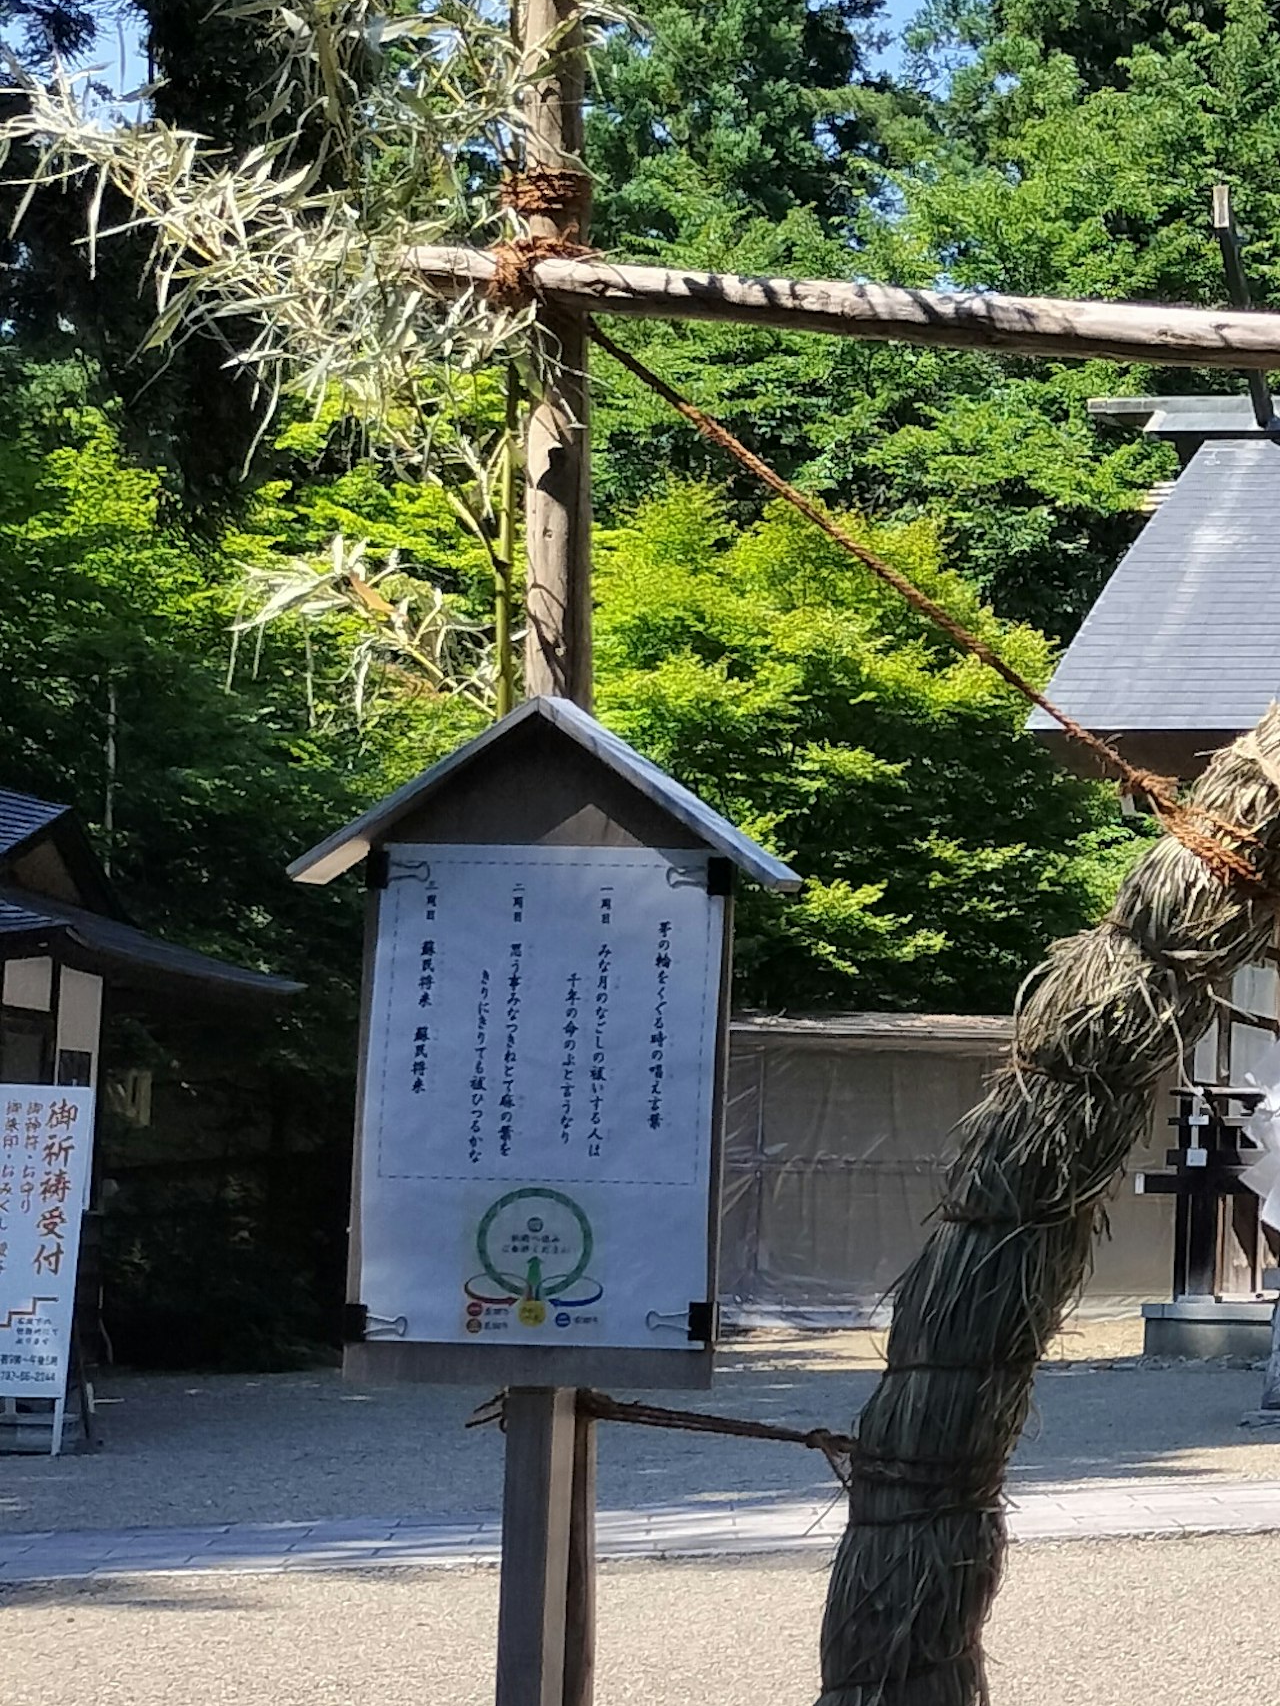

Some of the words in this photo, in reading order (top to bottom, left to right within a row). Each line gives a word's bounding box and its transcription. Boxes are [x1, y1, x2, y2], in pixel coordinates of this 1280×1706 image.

[418, 939, 437, 1008] 蘇民将来
[425, 881, 439, 921] 三周目
[512, 883, 525, 923] 二周目
[600, 886, 614, 924] 一周目
[411, 1025, 431, 1094] 蘇民将来
[469, 969, 490, 1164] きりにきりても祓ひつるかな
[499, 943, 523, 1157] 思う事みなつきねとて麻の葉を
[560, 973, 582, 1145] 千年の命のぶと言うなり
[588, 944, 613, 1158] みな月のなごしの祓いする人は
[647, 921, 672, 1131] 茅の輪をくぐる時の唱え言葉
[33, 1098, 79, 1276] 御祈祷受付
